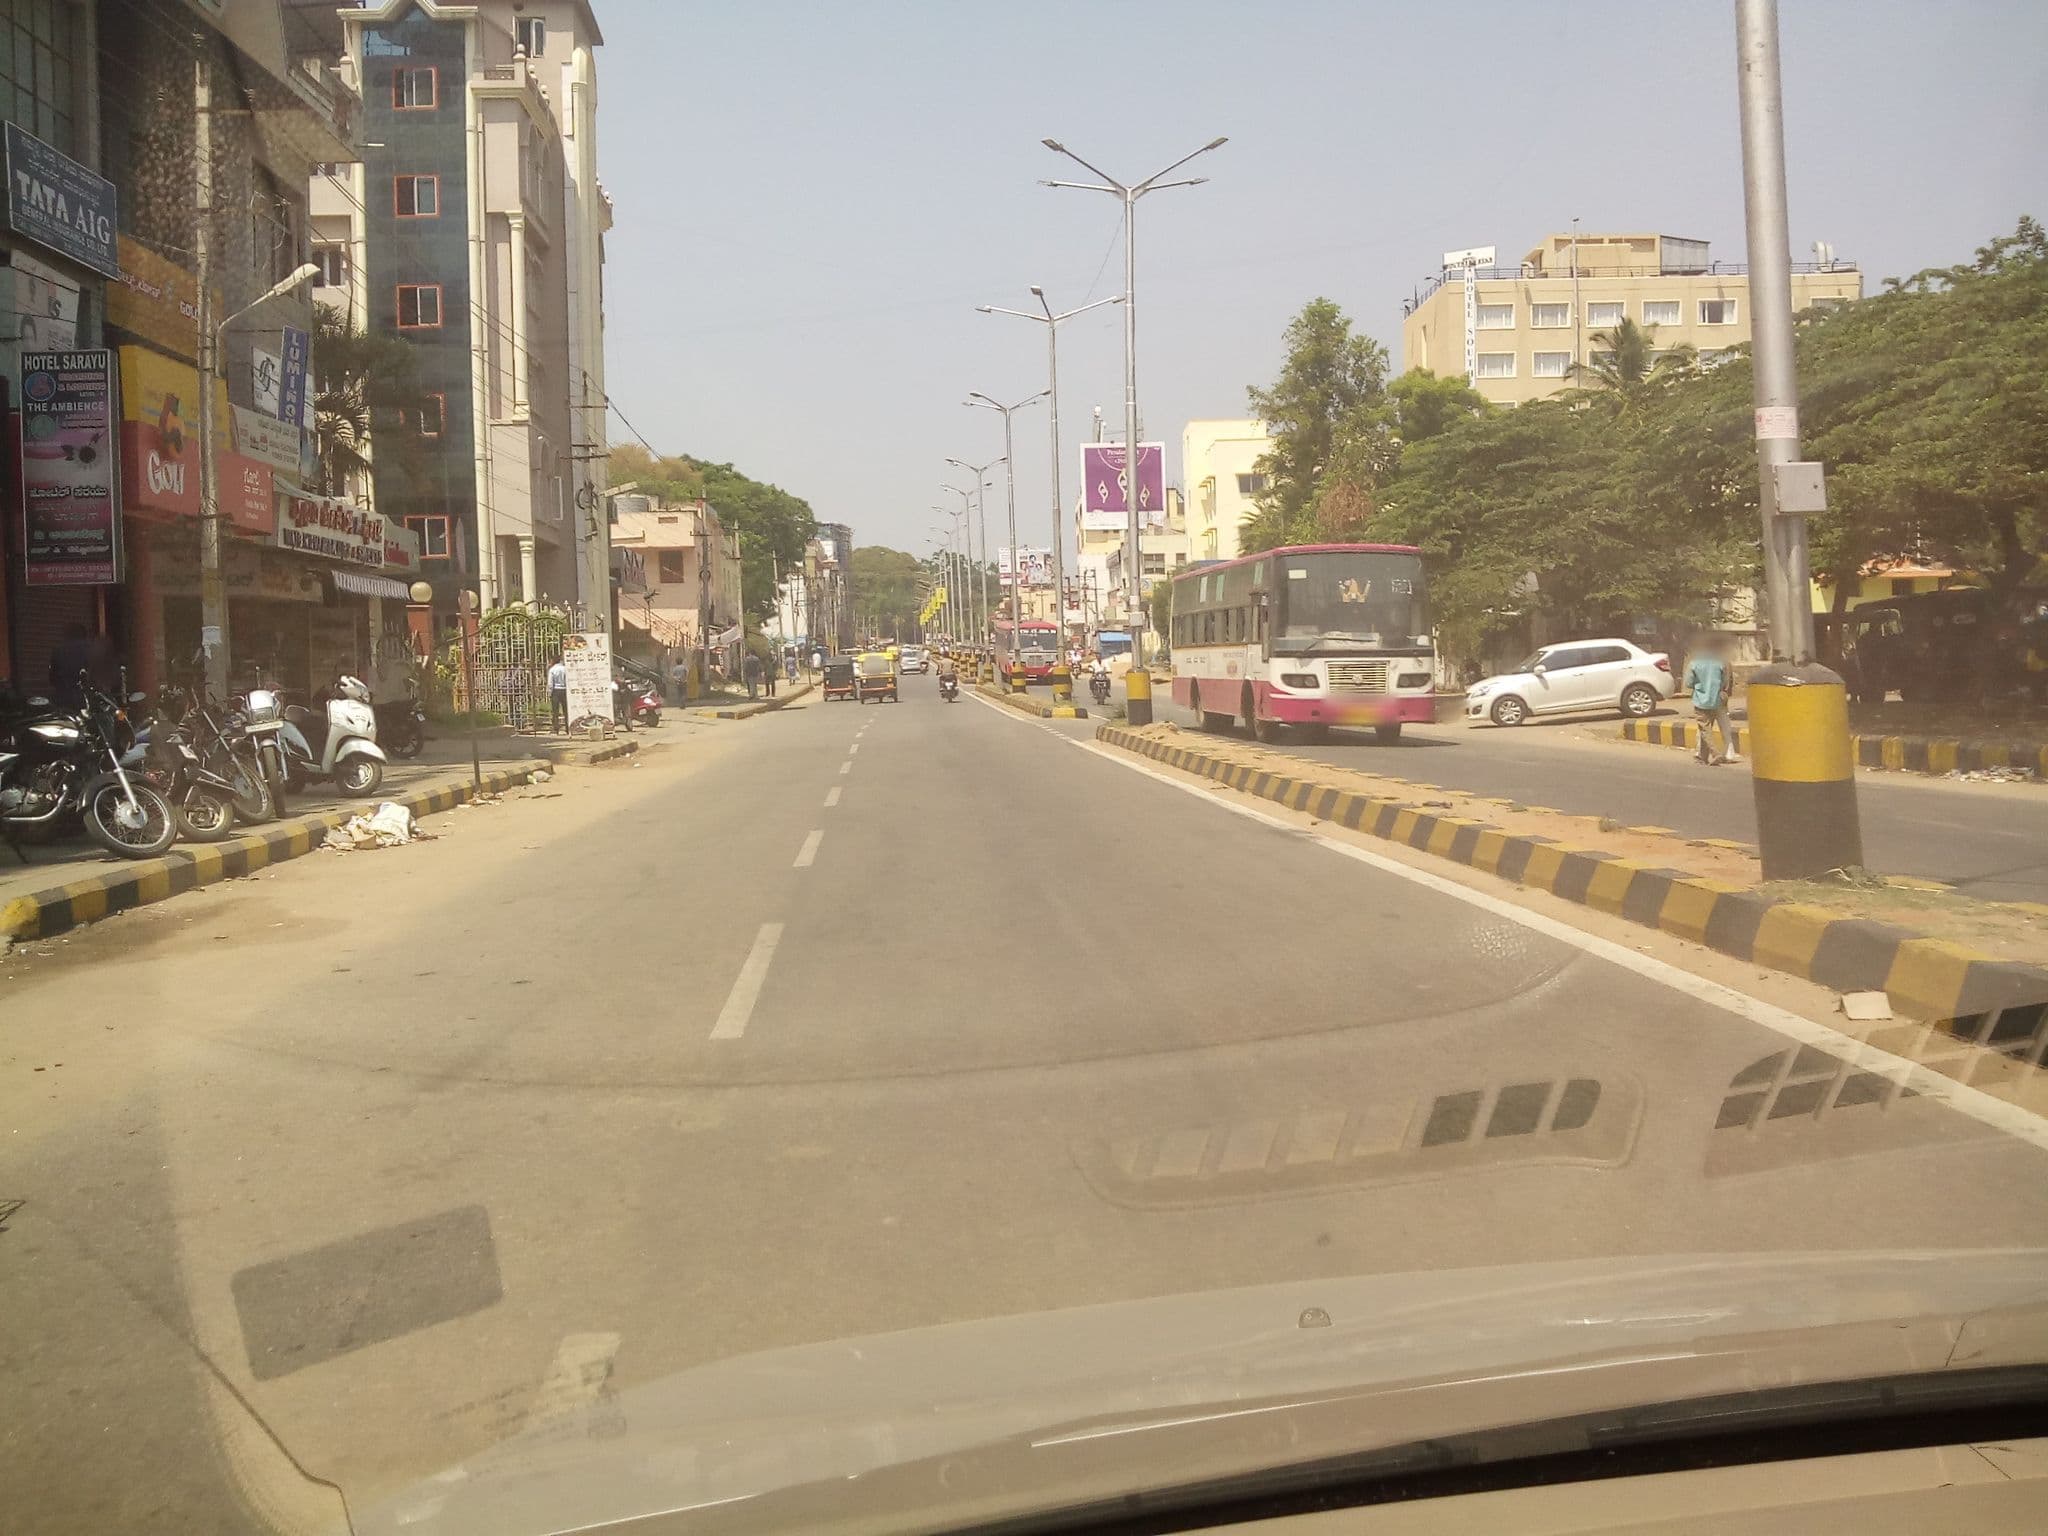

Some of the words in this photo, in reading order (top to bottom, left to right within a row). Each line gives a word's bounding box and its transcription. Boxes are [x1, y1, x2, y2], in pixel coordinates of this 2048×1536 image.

[16, 169, 70, 225] TATA
[75, 204, 111, 245] AIG
[1466, 277, 1474, 318] HOTEL
[24, 355, 60, 370] HOTEL
[63, 354, 105, 370] SARAYU
[27, 402, 48, 412] THE
[50, 401, 105, 412] AMBIENCE
